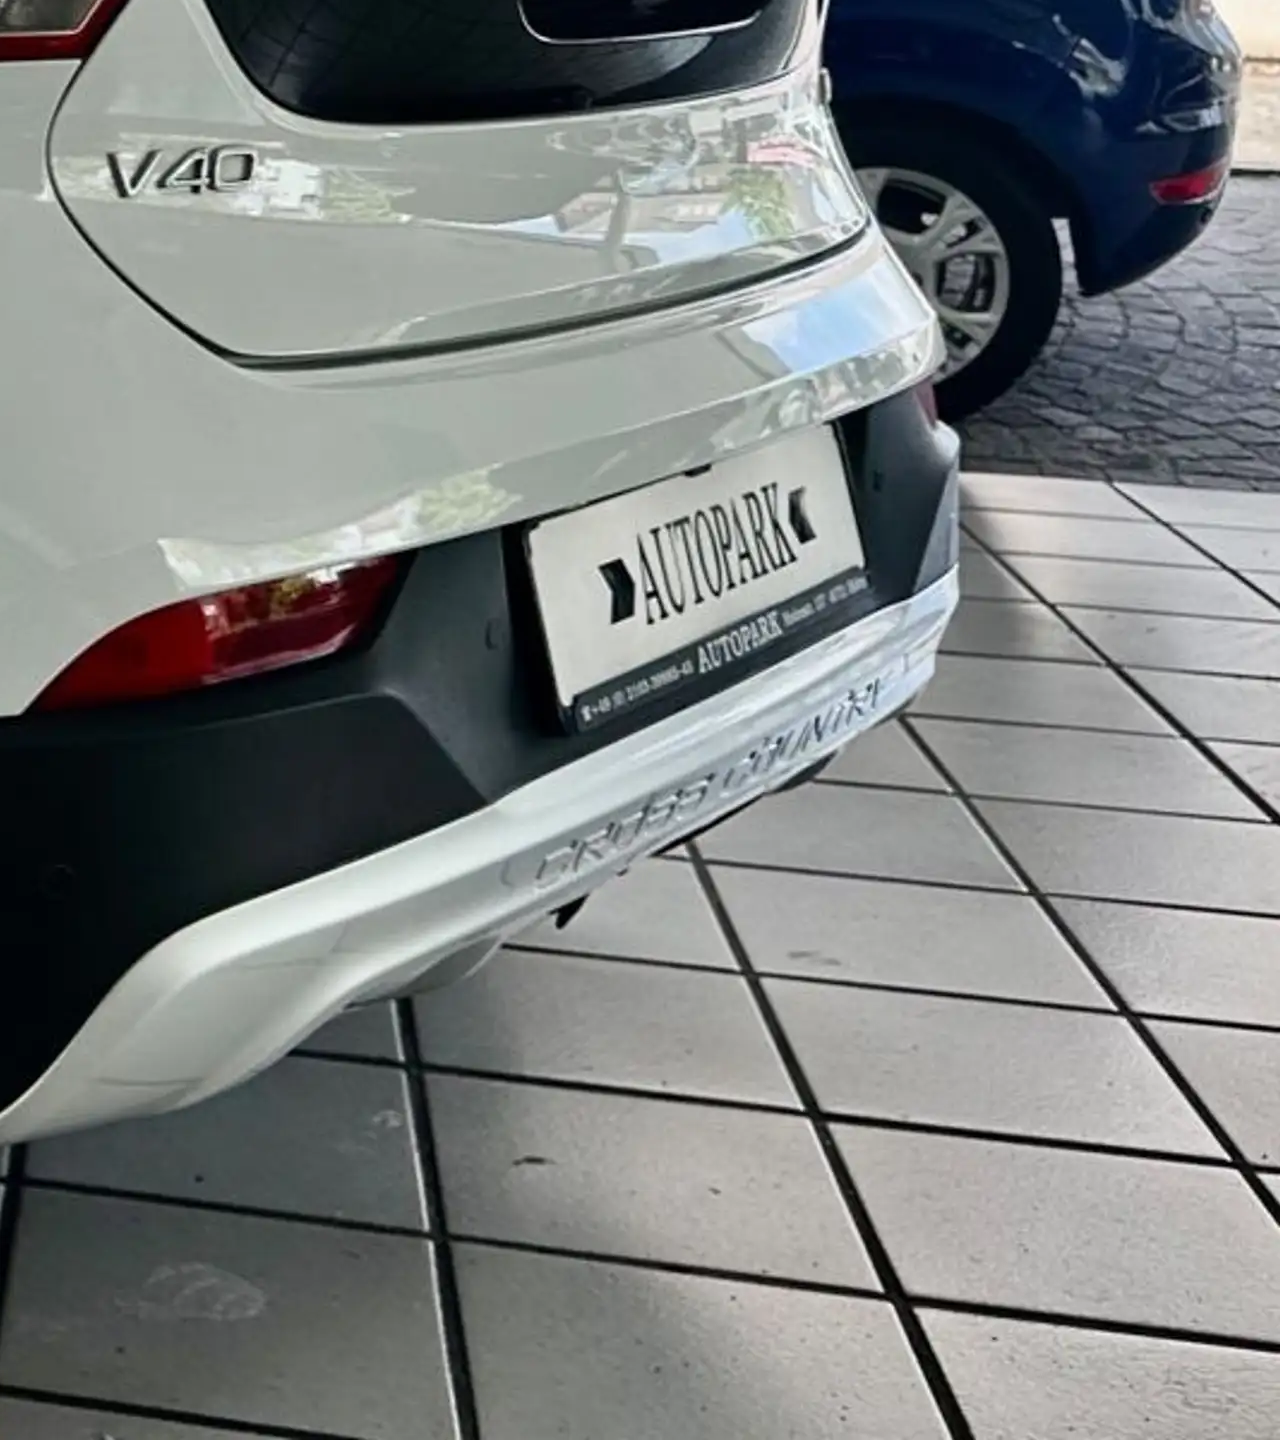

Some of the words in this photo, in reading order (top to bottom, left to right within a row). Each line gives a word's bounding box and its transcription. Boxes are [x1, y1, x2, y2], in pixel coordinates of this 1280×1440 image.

[105, 144, 258, 199] V40
[636, 481, 798, 625] AUTOPARK
[697, 610, 783, 674] AUTOPARK
